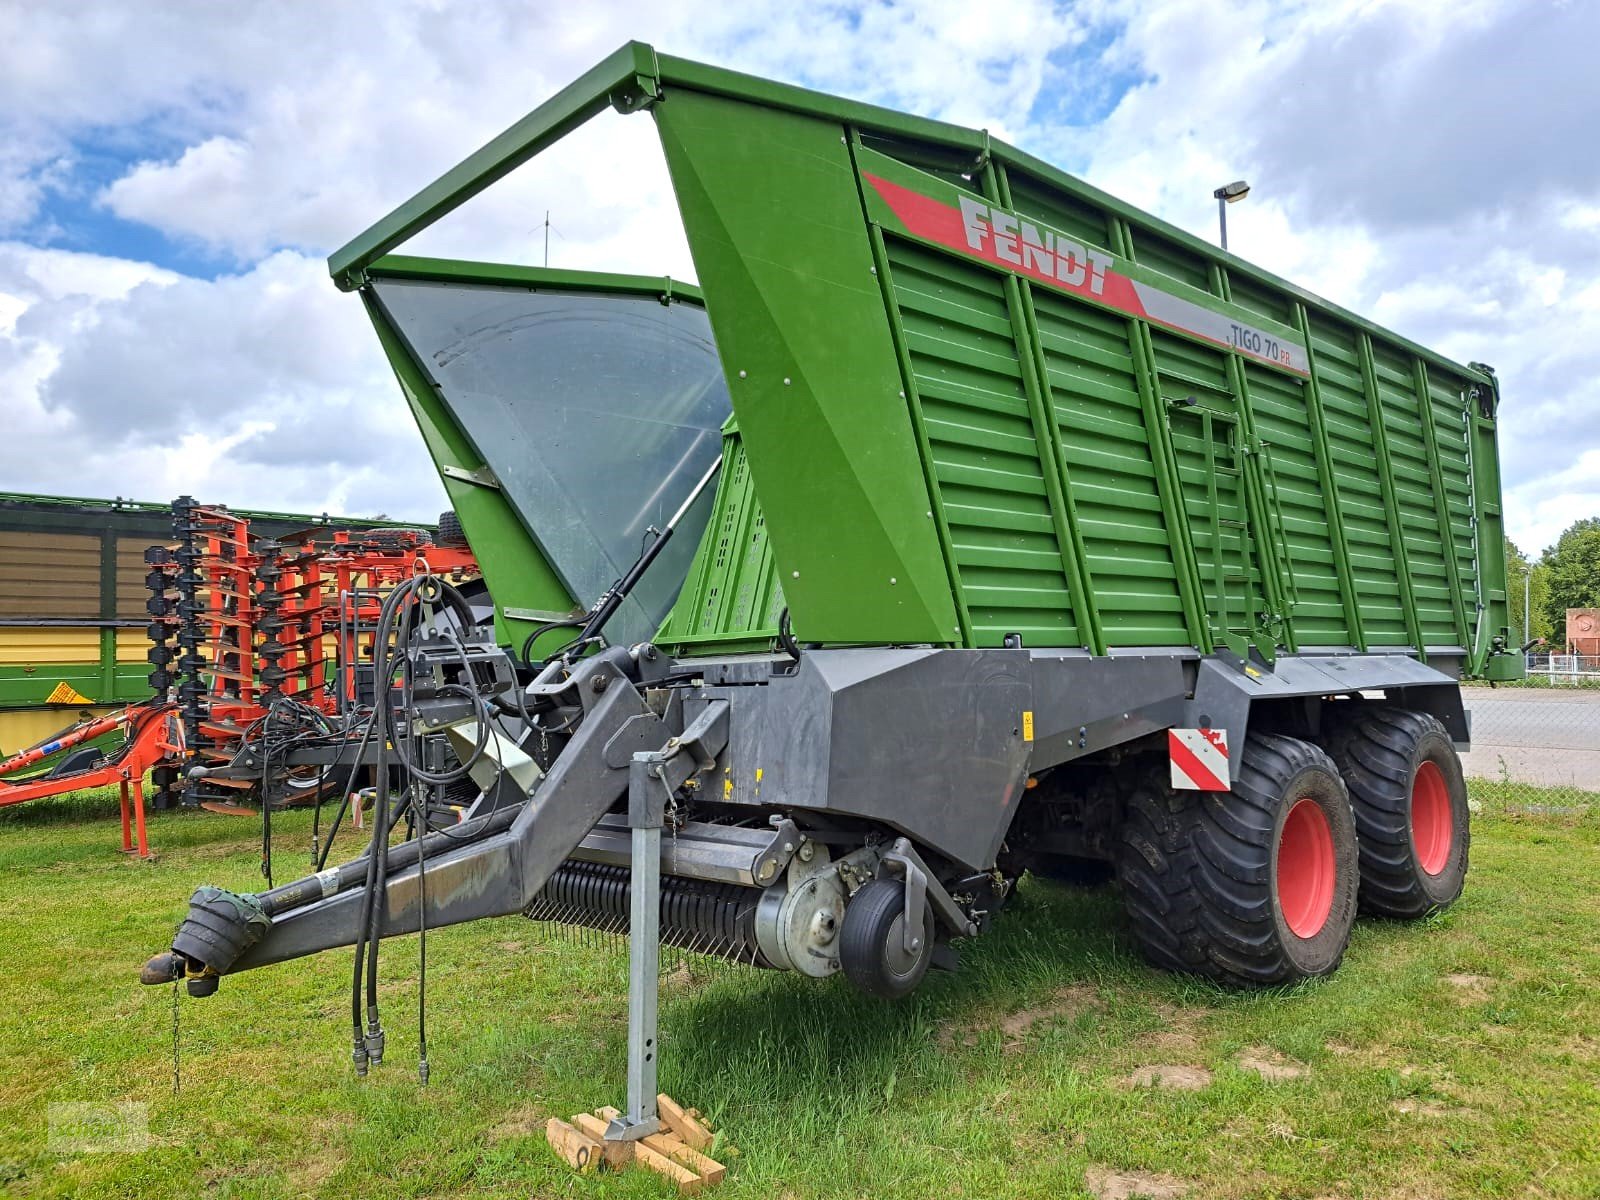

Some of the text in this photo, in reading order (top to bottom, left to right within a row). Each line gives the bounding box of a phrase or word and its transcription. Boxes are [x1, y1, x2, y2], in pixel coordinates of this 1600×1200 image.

[958, 194, 1114, 296] FENDT
[1231, 324, 1291, 365] TIGO 70 PR
